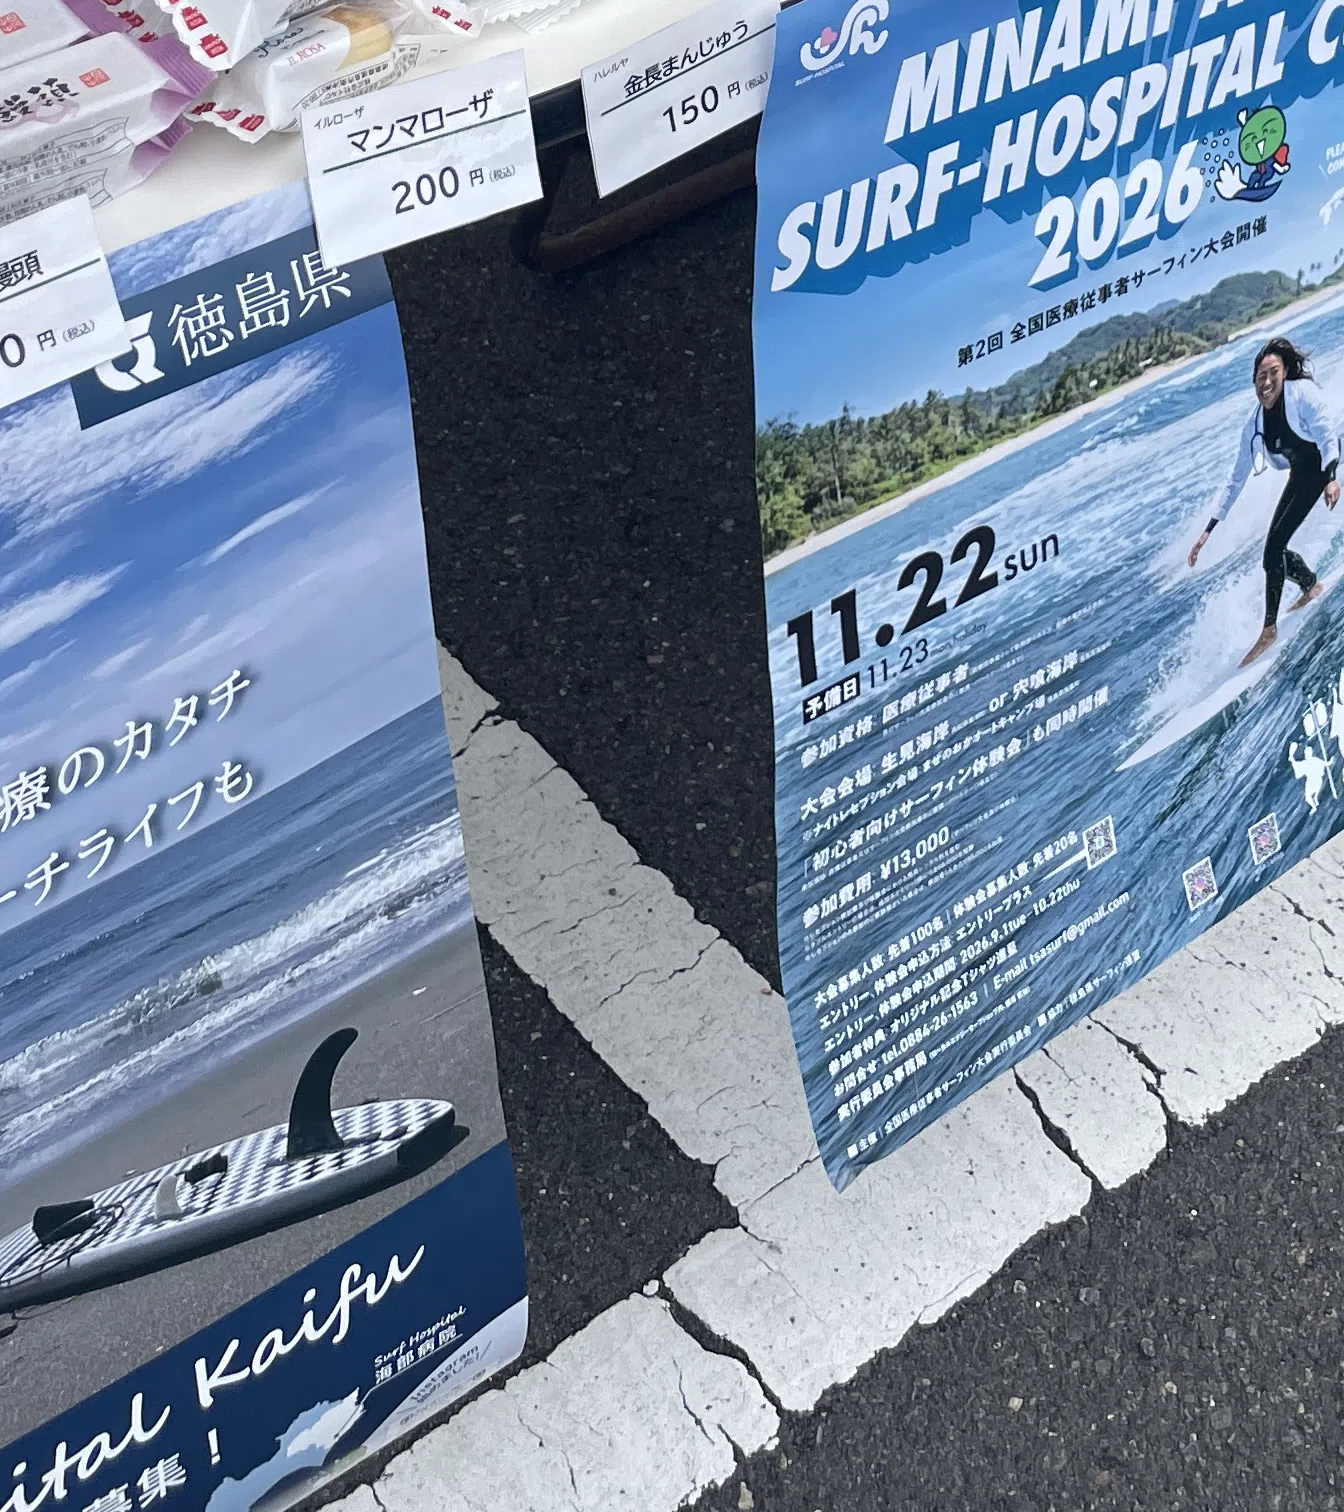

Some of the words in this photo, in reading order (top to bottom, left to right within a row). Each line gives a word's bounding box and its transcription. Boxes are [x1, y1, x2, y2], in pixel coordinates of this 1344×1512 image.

[297, 41, 327, 64] ROSA
[593, 57, 629, 82] ハレルヤ
[623, 19, 749, 99] 金長まんじゅう
[313, 105, 365, 130] イルローザ
[347, 88, 494, 153] マンマローザ
[662, 84, 719, 133] 150
[727, 80, 741, 100] 円
[770, 19, 1289, 292] SURF-HOSPITAL
[391, 166, 460, 215] 200
[469, 167, 485, 187] 円
[1027, 140, 1205, 289] 2026
[166, 253, 353, 370] 徳島県
[957, 328, 1006, 369] 第2回
[1009, 213, 1270, 345] 全国医療従事者サーフィン大会開催
[37, 329, 58, 352] 円
[787, 525, 999, 688] 11.22
[1003, 533, 1059, 582] sun
[805, 676, 859, 719] 予備日
[867, 638, 930, 689] 11.23
[882, 662, 970, 724] 医療従事者
[881, 720, 950, 775] 生見海岸
[988, 692, 1009, 713] or
[879, 826, 950, 881] ¥13,000
[193, 1244, 427, 1410] Kaifu
[374, 1339, 407, 1369] Surf
[409, 1304, 468, 1348] Hospital
[374, 1323, 459, 1386] 海部病院
